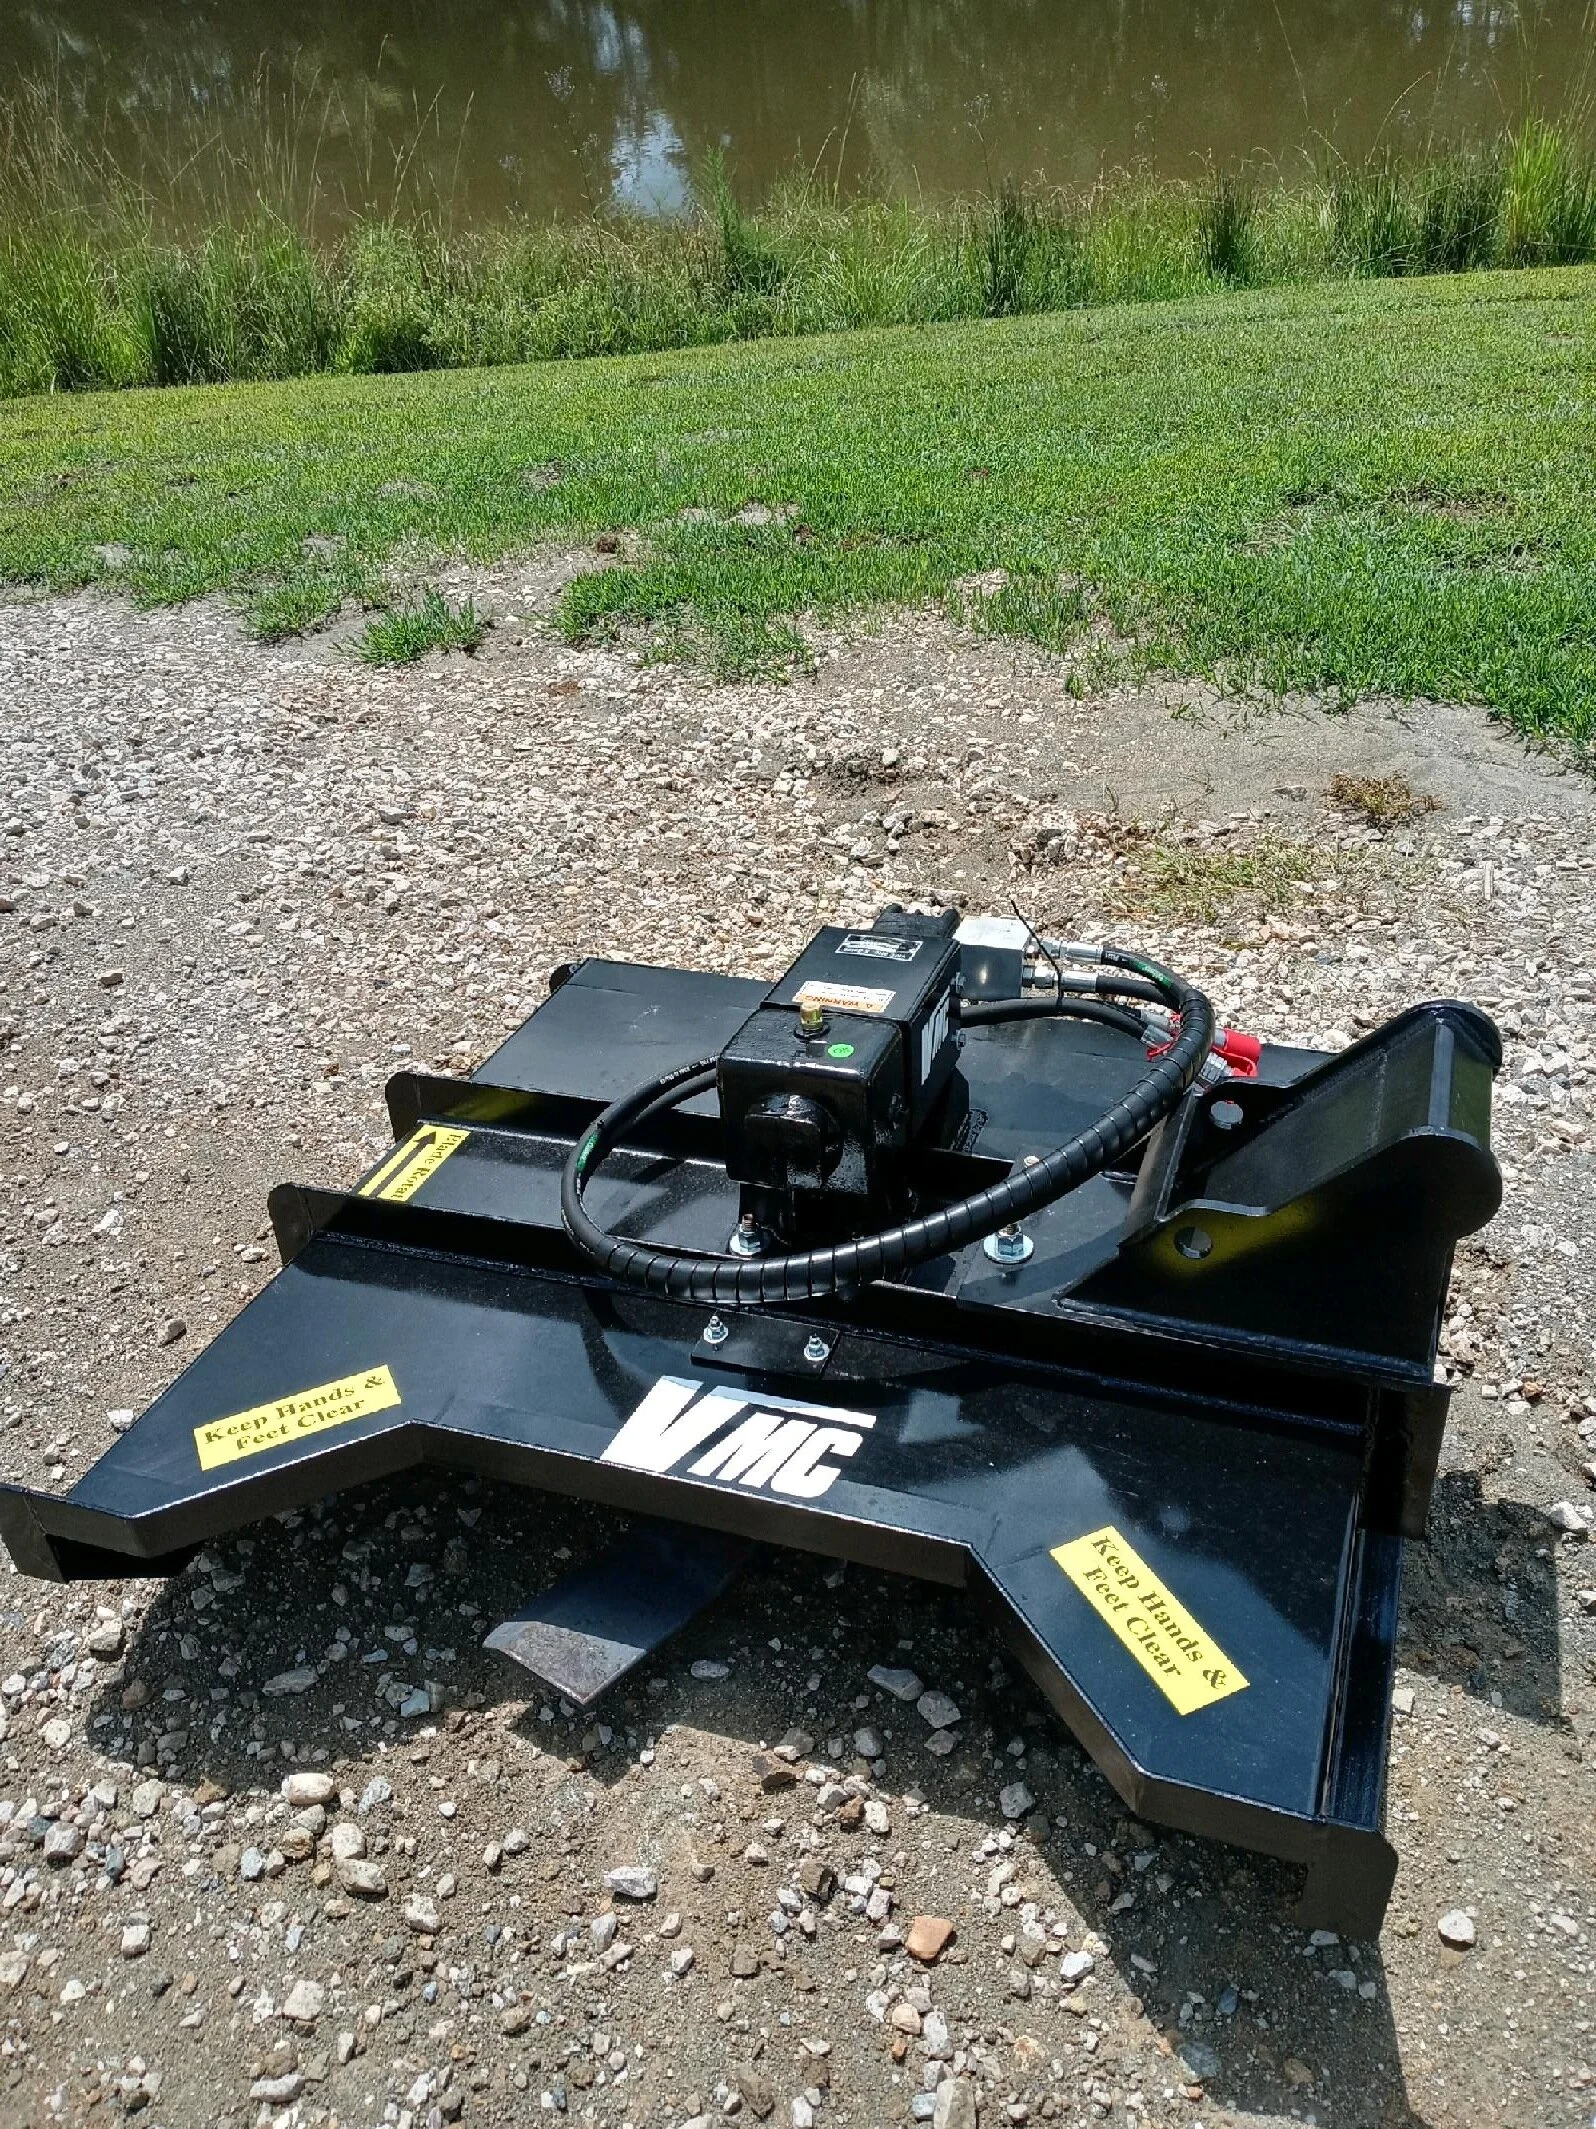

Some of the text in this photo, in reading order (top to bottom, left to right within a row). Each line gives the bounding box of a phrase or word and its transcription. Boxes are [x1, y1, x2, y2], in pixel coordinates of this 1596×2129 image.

[424, 1133, 462, 1164] Blade
[204, 1375, 386, 1445] Keep Hands &
[235, 1399, 365, 1450] Feet Clear
[600, 1375, 877, 1498] VMC
[1082, 1564, 1181, 1677] Feet Clear
[1090, 1535, 1227, 1690] Keep Hands &
